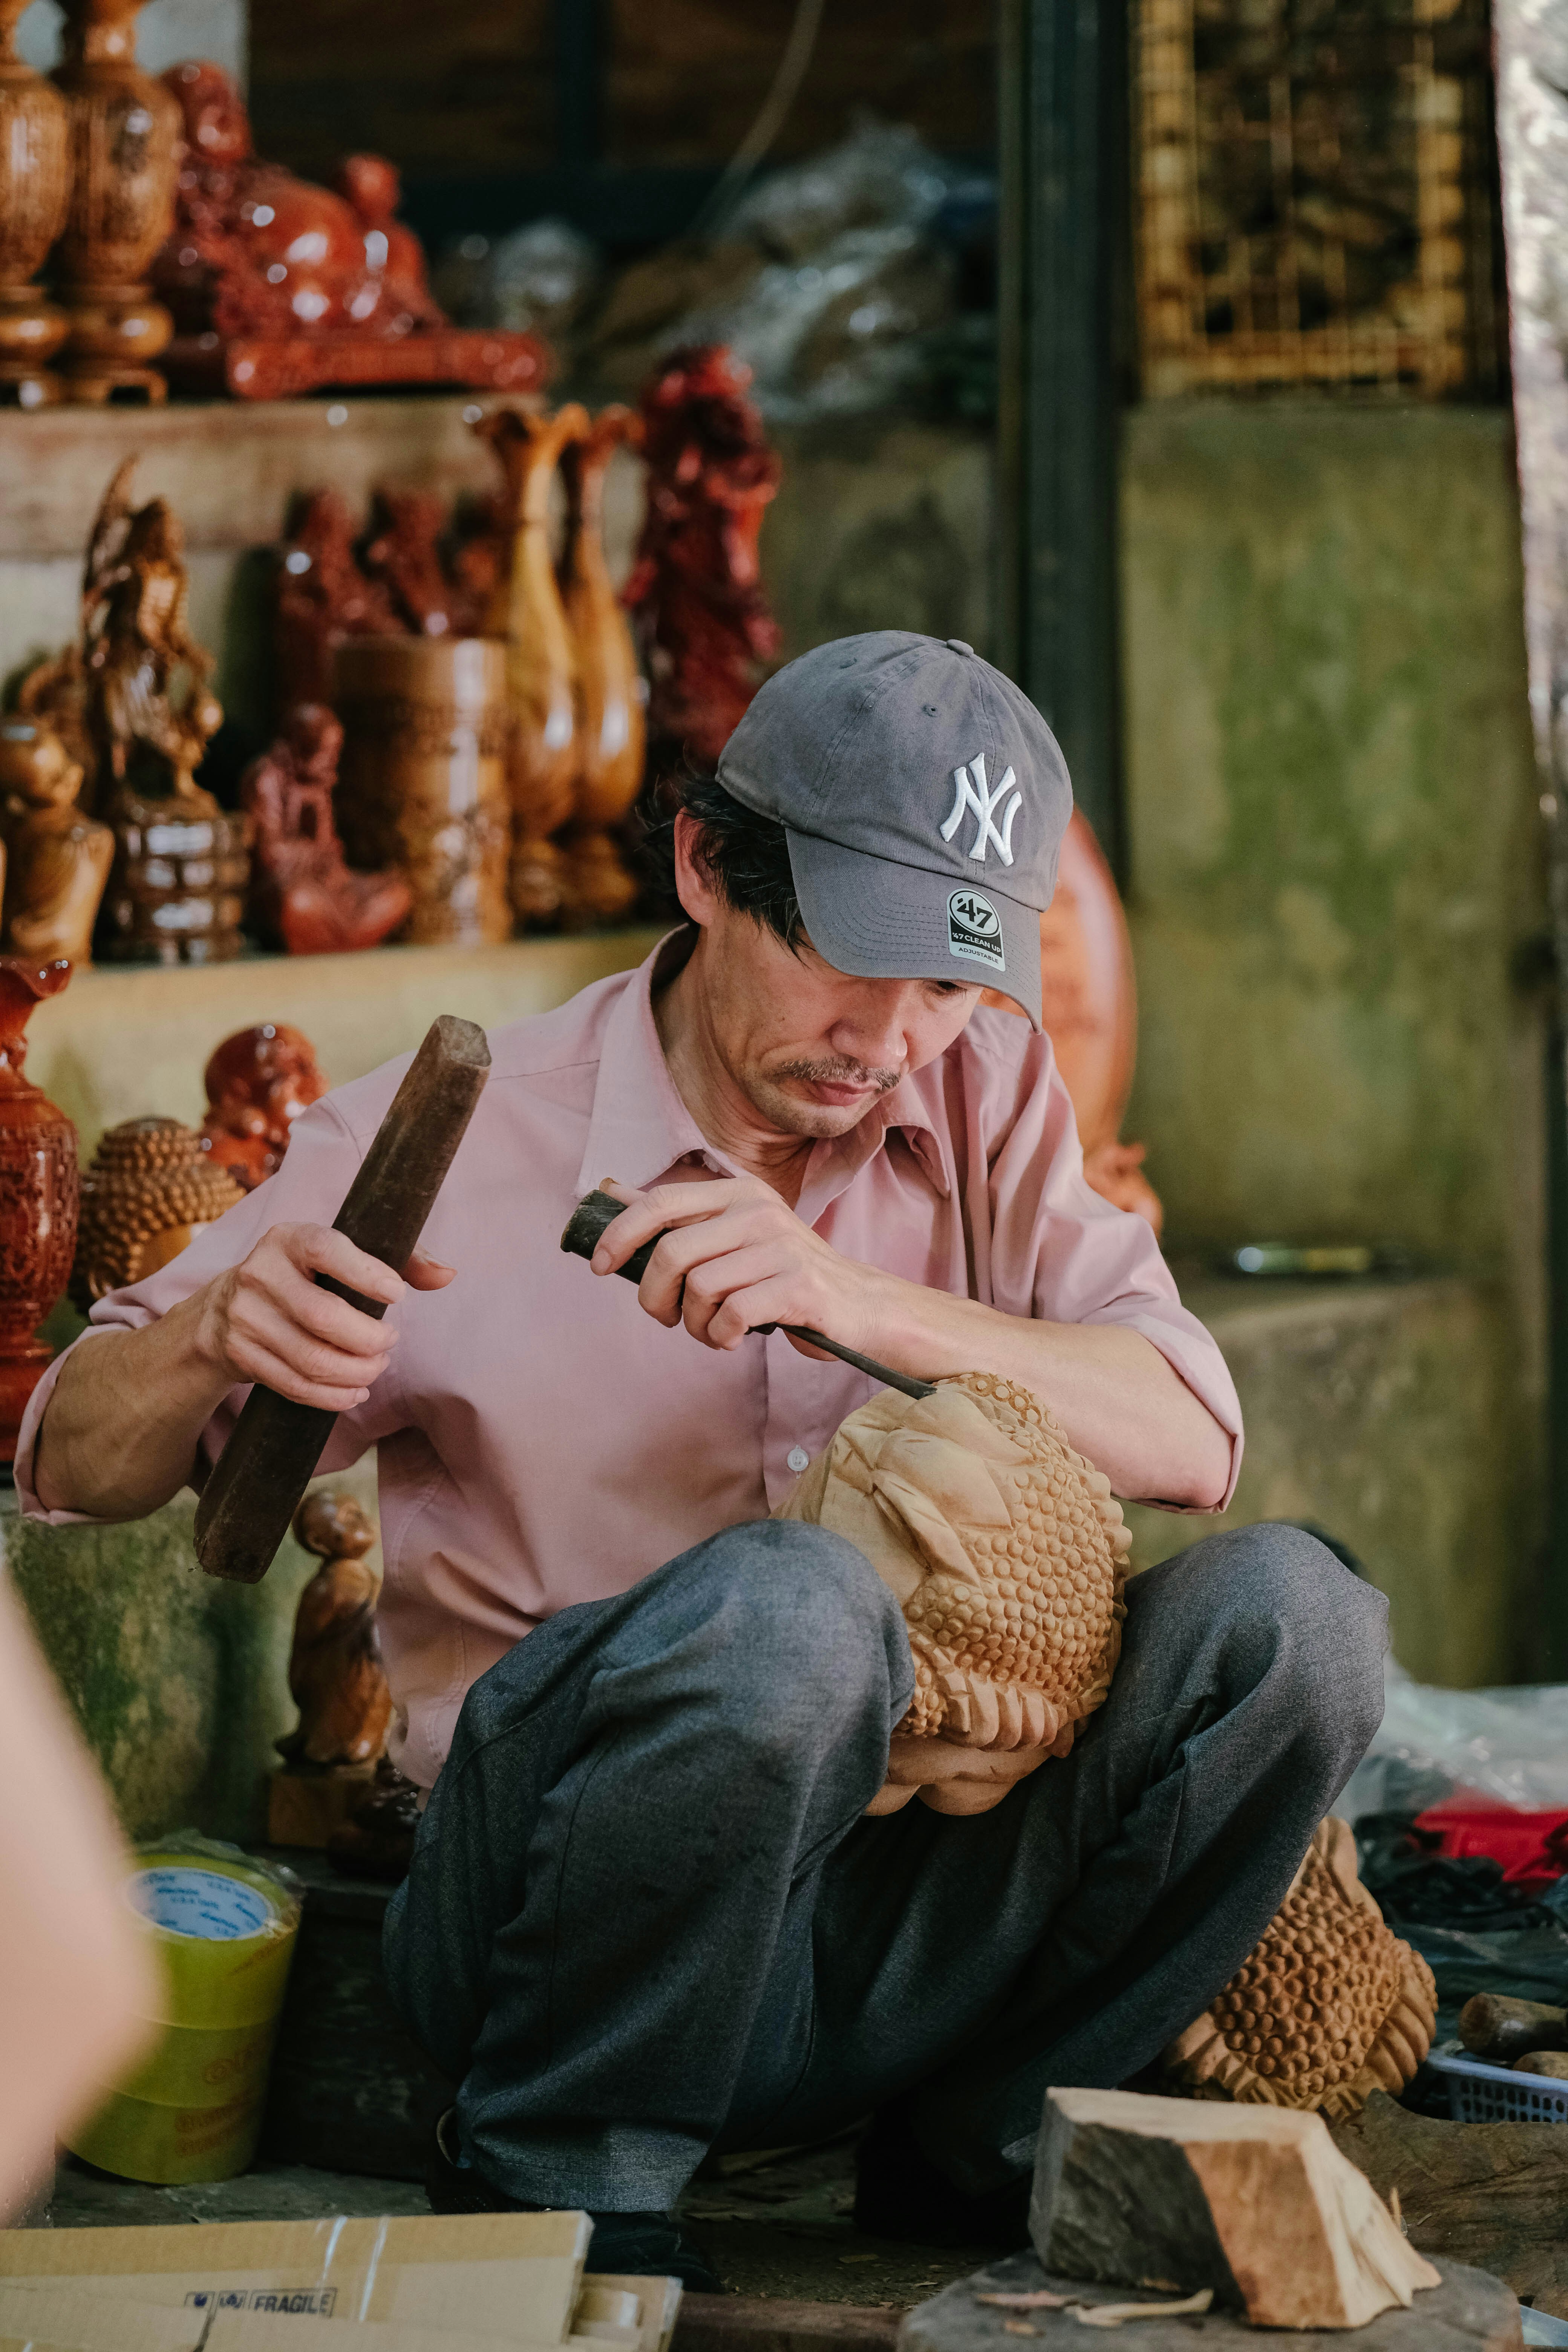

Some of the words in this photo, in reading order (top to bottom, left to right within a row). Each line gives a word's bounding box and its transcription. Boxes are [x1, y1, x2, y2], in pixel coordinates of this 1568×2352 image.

[940, 752, 1022, 867] NY
[964, 935, 990, 948] CLEAN
[991, 944, 1001, 953] UP
[959, 947, 999, 964] ADJUSTABLE
[254, 2293, 331, 2314] FRAGILE
